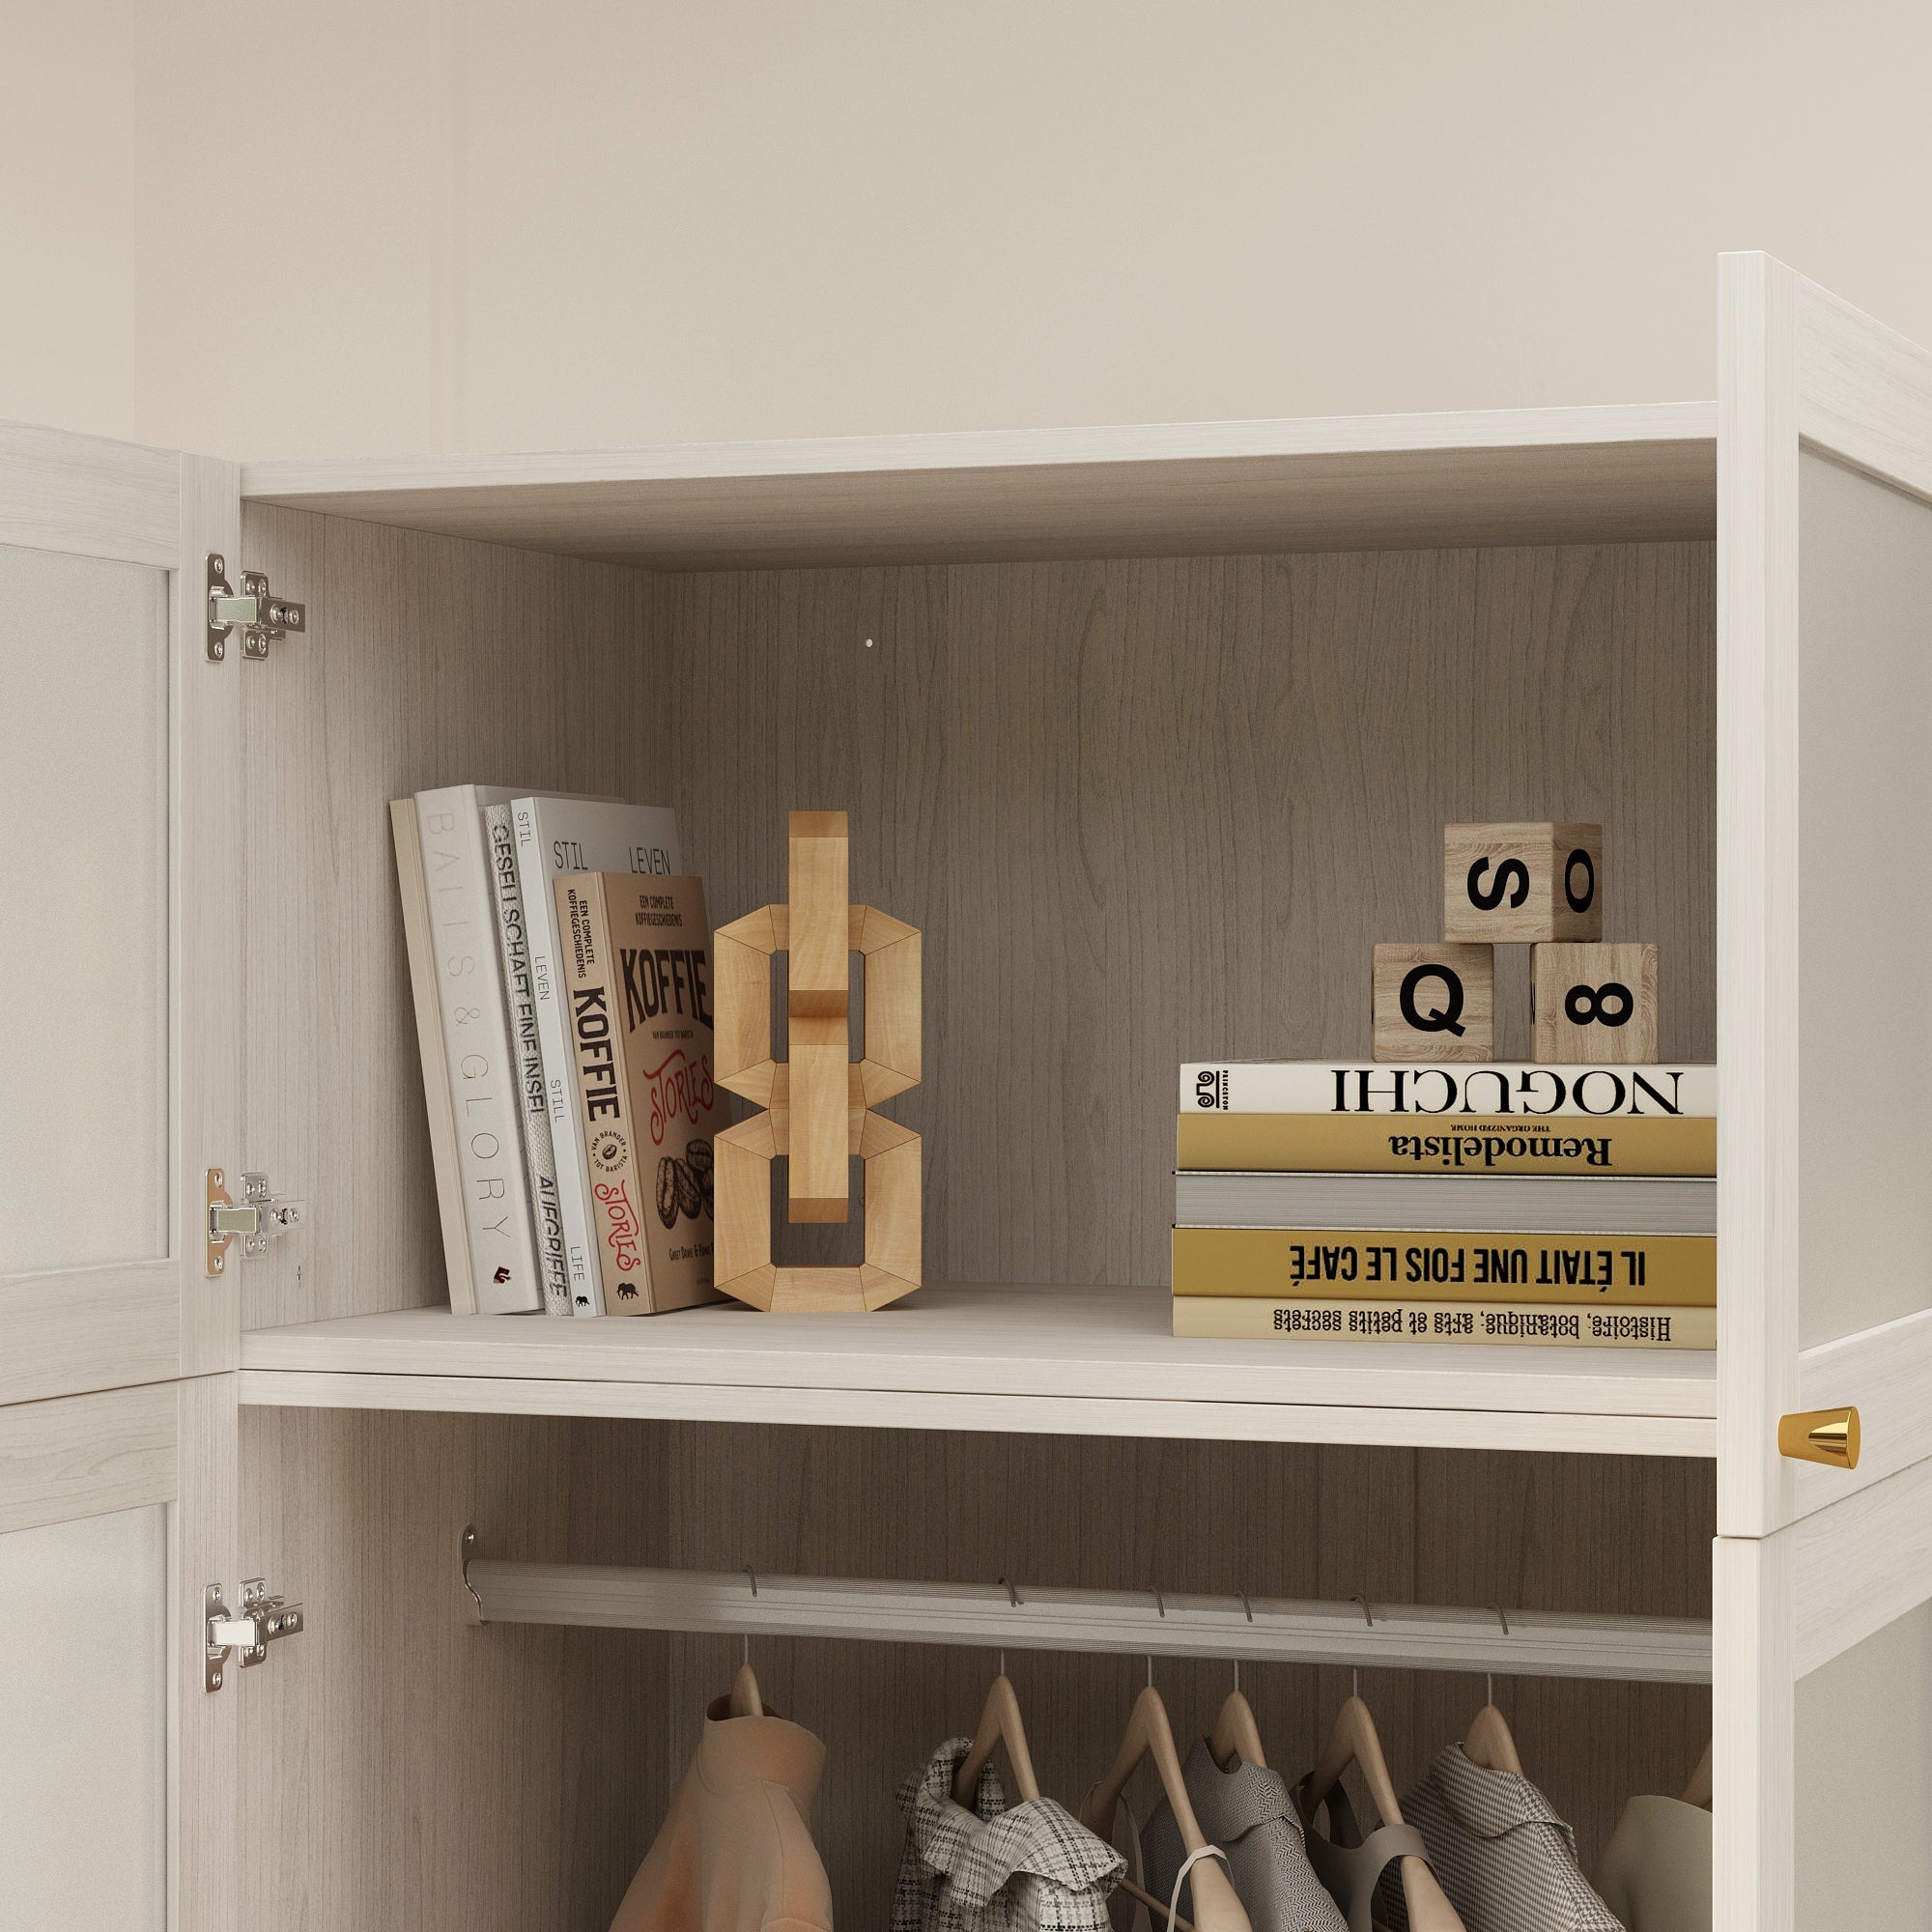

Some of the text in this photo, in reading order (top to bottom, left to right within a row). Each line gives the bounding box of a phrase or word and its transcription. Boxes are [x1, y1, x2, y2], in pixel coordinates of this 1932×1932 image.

[554, 840, 587, 870] STIL
[629, 846, 670, 875] LEVEN
[567, 889, 586, 979] KOFFIEGESCHIEDENIS
[580, 899, 595, 965] EEN COMPLETE
[620, 949, 715, 1034] KOFFIE
[1400, 963, 1466, 1037] Q
[1564, 982, 1634, 1029] 8
[427, 812, 475, 978] BALLS
[460, 1054, 511, 1238] GLORY
[518, 811, 584, 1282] STIL LEVEN STILL LIFE
[573, 985, 620, 1122] KOFFIE
[643, 1049, 714, 1146] STORIES
[1330, 1069, 1685, 1116] NOGUCHI
[591, 1130, 626, 1151] VAN BRANDER
[605, 1155, 628, 1173] BARISTA
[1388, 1135, 1612, 1168] Remodelista
[594, 1179, 641, 1271] STORIES
[1289, 1245, 1646, 1293] IL ÉTAIT UNE FOIS LE CAFÉ
